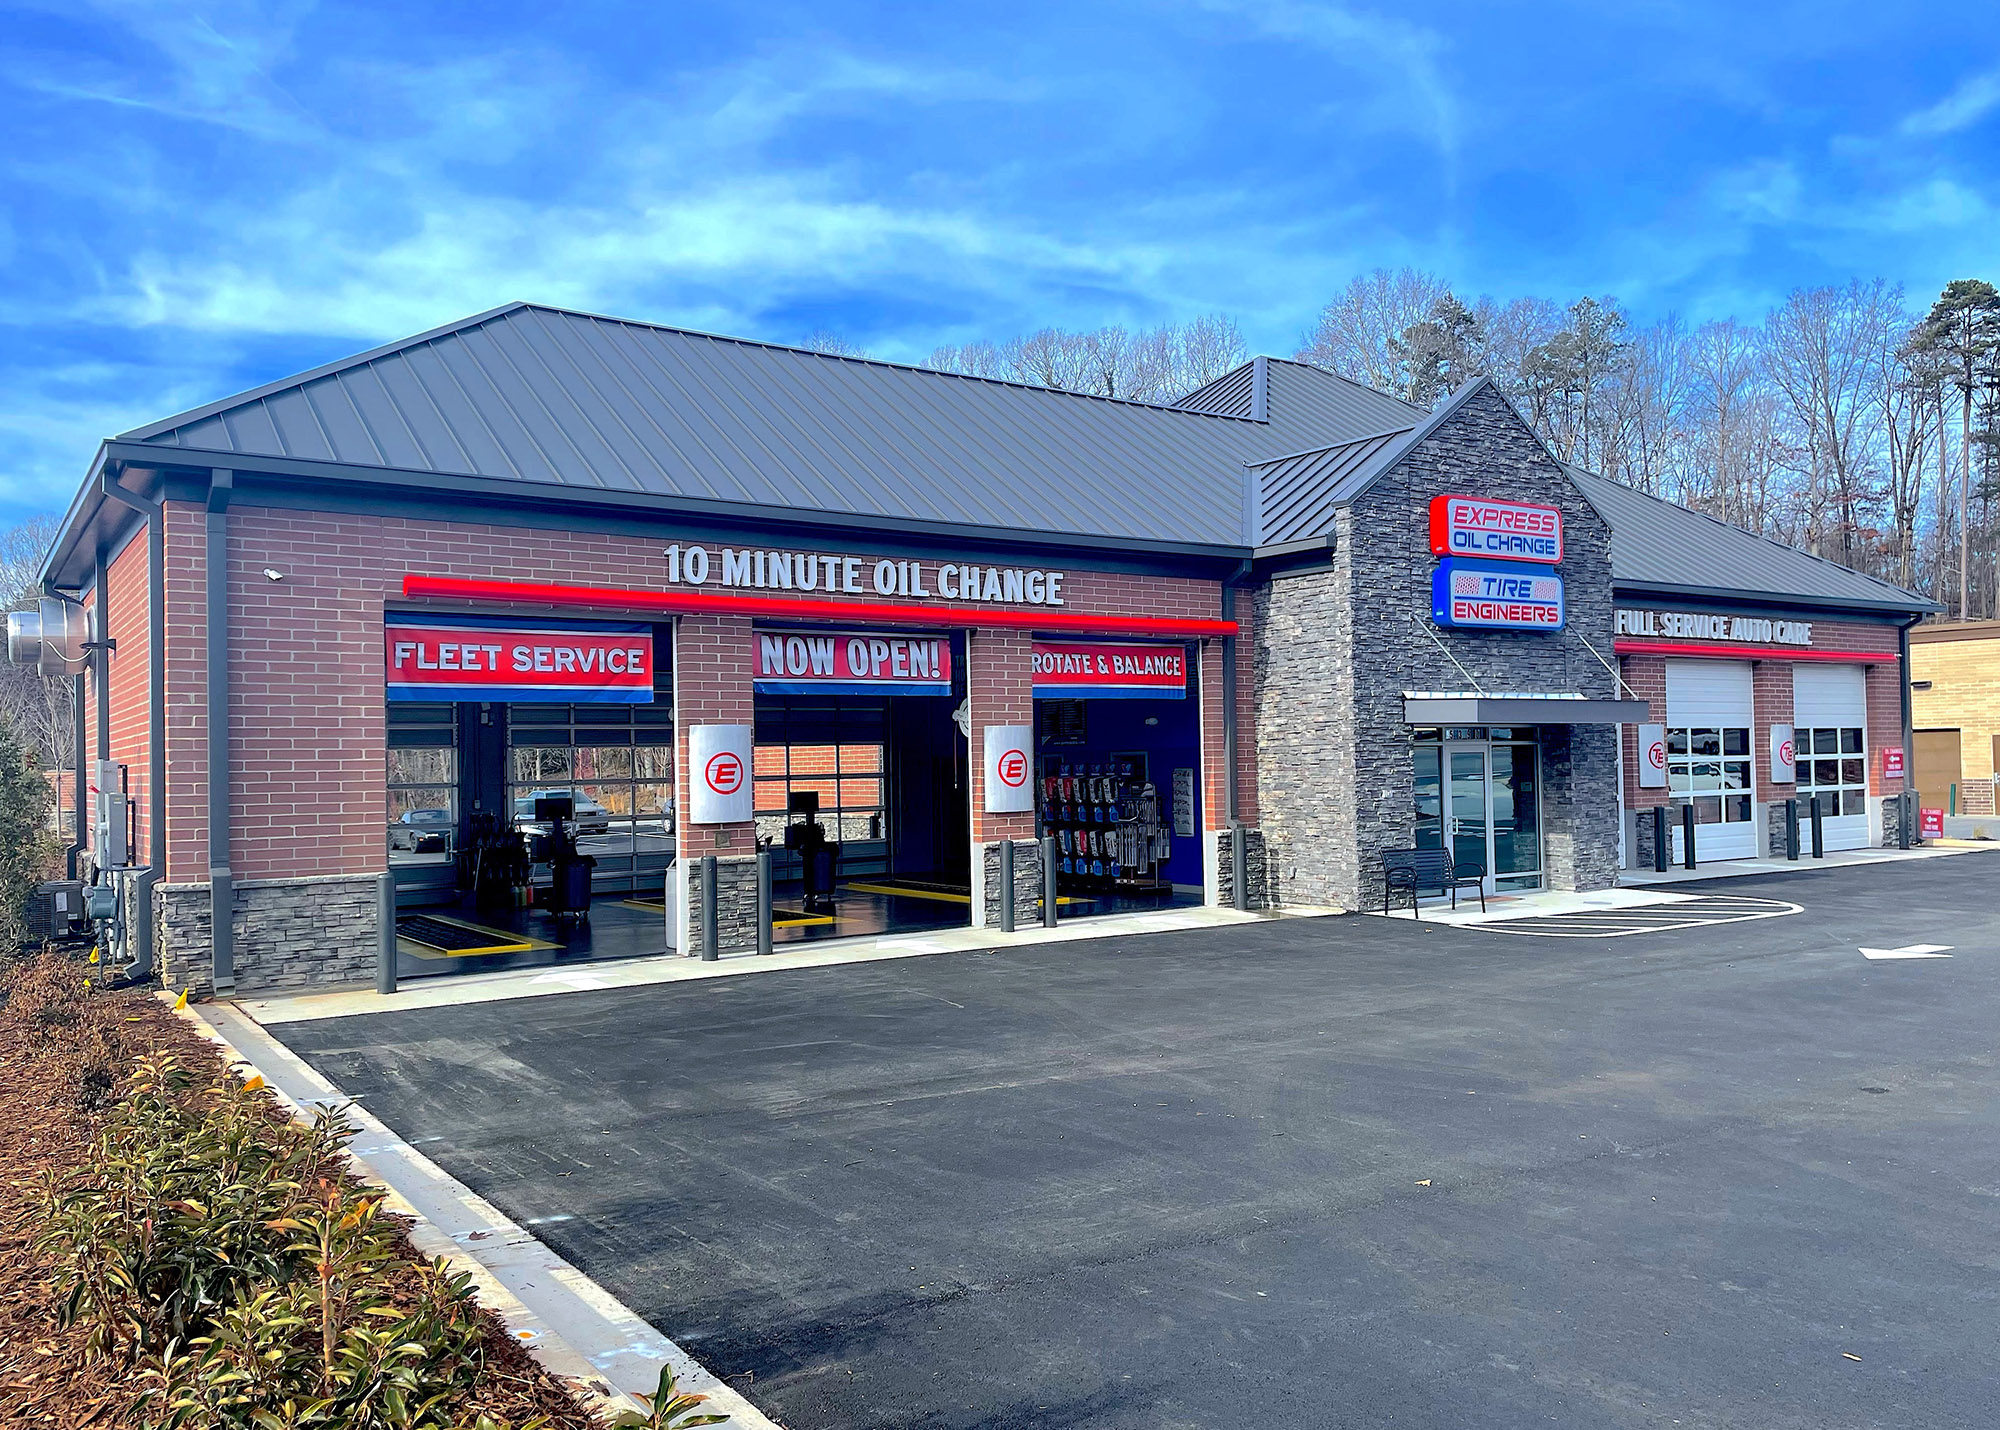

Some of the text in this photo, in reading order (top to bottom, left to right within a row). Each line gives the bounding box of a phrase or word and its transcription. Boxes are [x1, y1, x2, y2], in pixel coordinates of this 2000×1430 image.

[1454, 506, 1555, 533] EXPRESS
[1454, 531, 1556, 555] OIL CHANGE
[663, 544, 1065, 606] 10 MINUTE OIL CHANGE
[1483, 577, 1533, 598] TIRE
[1454, 602, 1559, 623] ENGINEERS
[1614, 610, 1813, 646] FULL SERVICE AUTO CARE
[394, 641, 645, 674] FLEET SERVICE
[760, 635, 942, 679] NOW OPEN!
[1032, 652, 1094, 675] ROTATE
[1096, 654, 1110, 675] &
[1112, 655, 1182, 676] BALANCE
